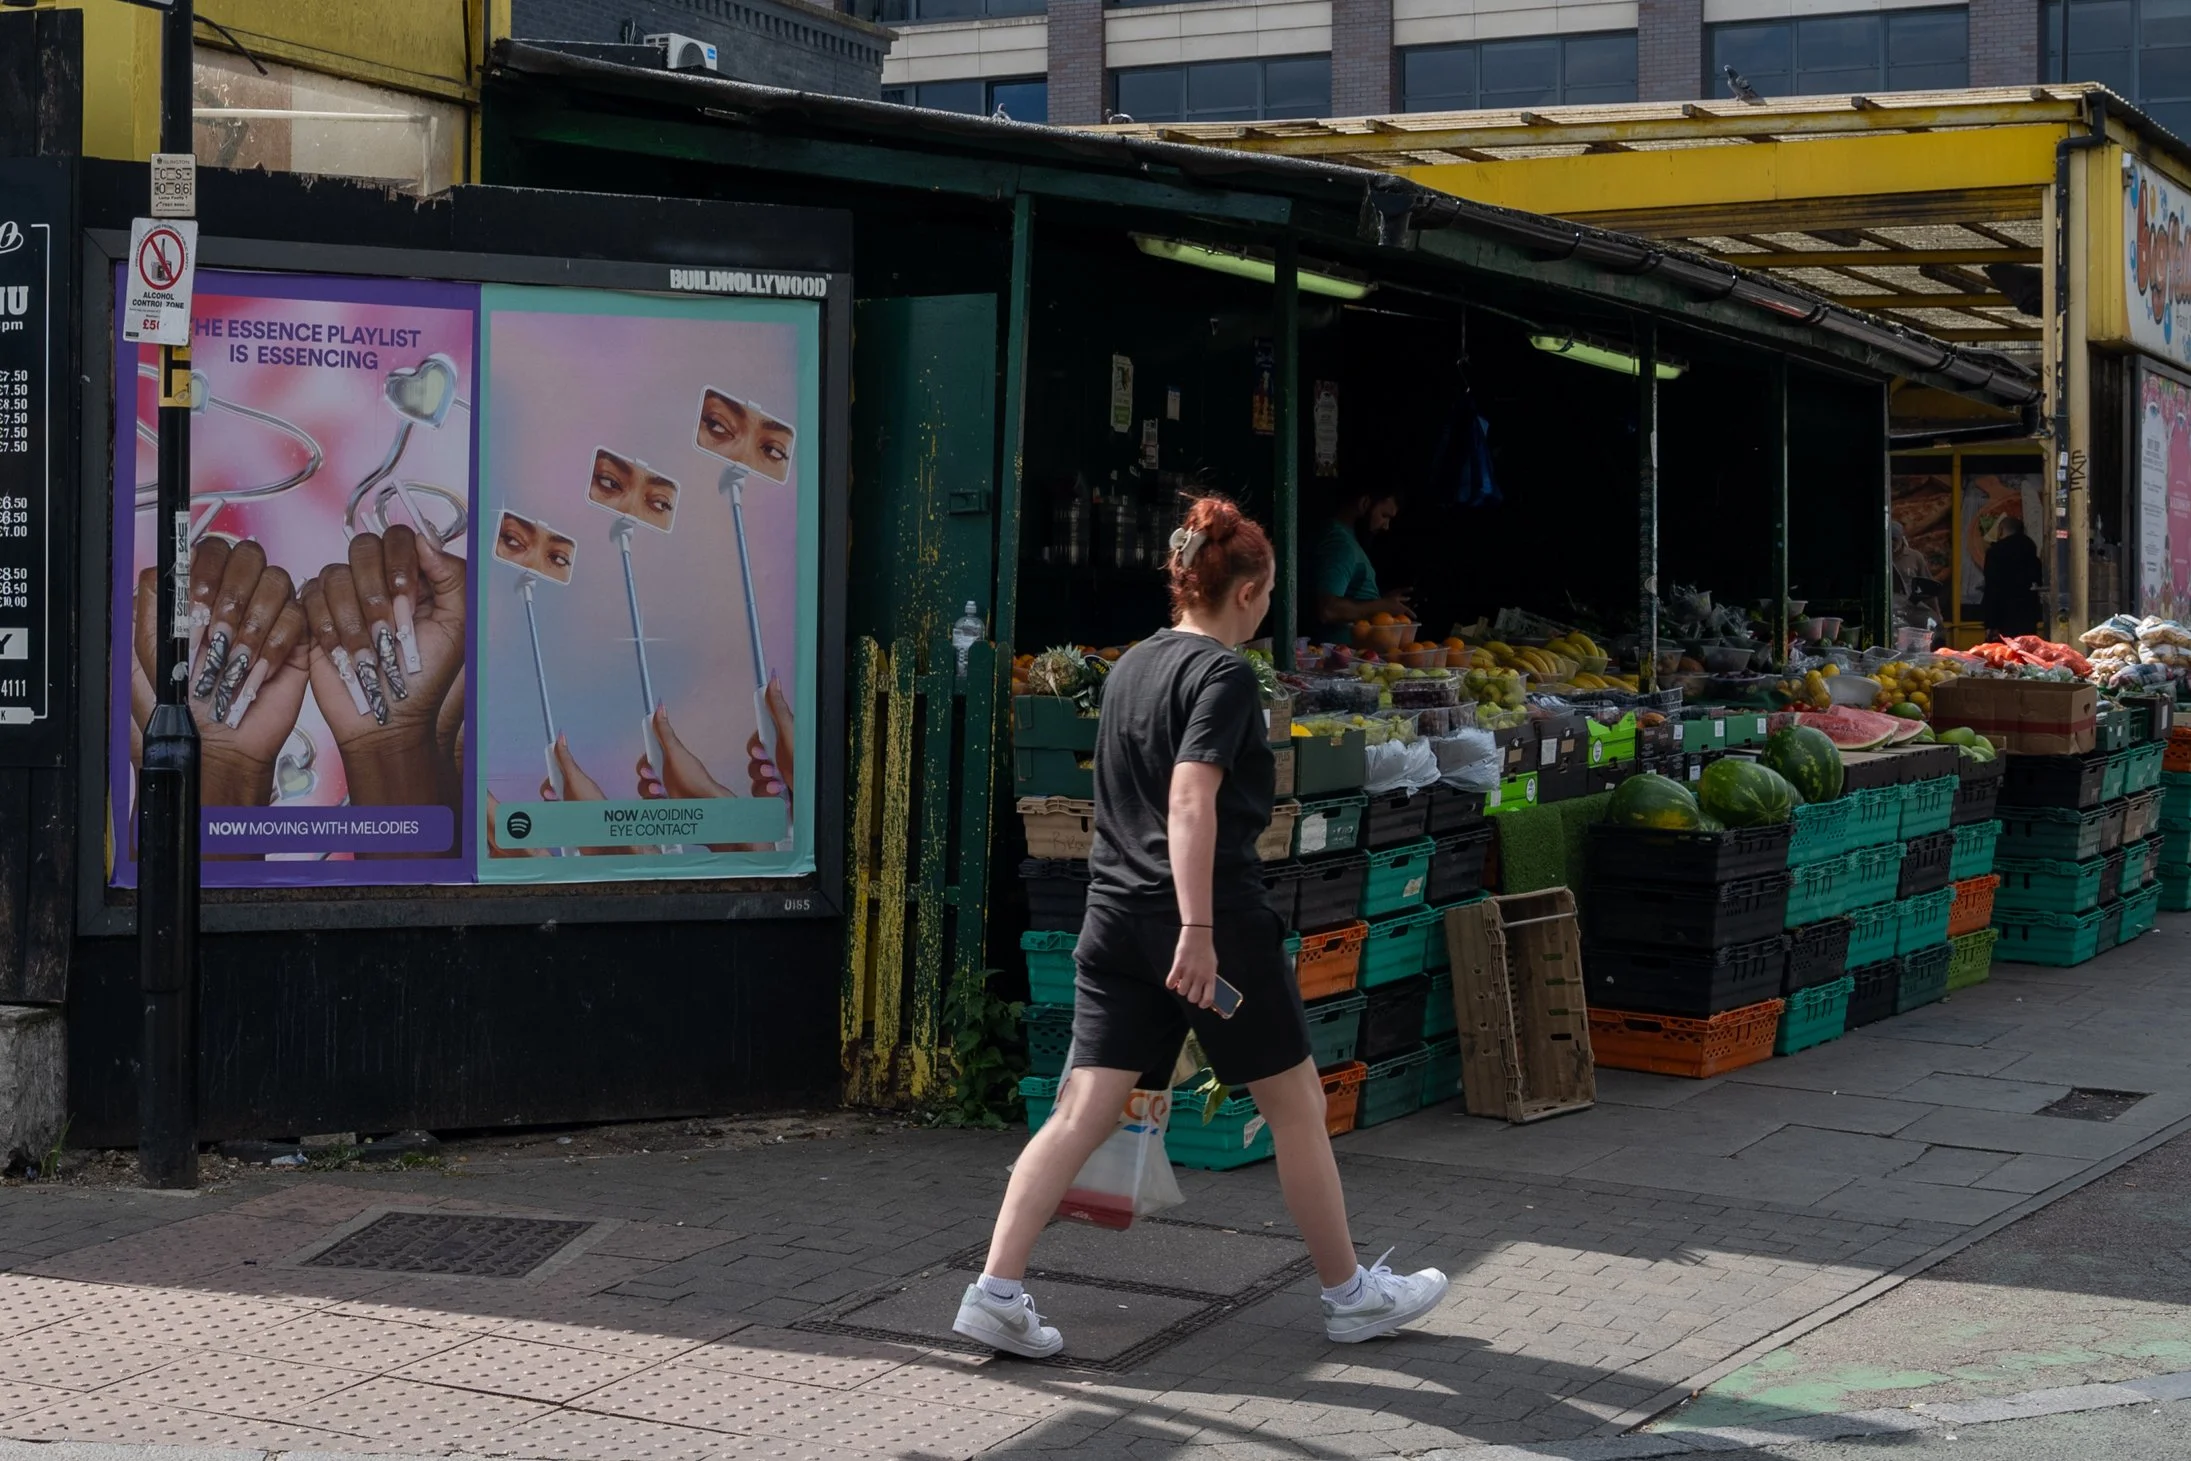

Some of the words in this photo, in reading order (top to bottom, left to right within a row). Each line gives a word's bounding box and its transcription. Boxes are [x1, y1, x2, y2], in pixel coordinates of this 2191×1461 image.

[670, 269, 827, 297] BUILDHOLLYWOOD
[142, 291, 175, 300] ALCOHOL
[228, 319, 322, 343] ESSENCE
[327, 325, 421, 348] PLAYLIST
[229, 344, 249, 363] IS
[257, 346, 378, 370] ESSENCING
[1, 679, 26, 697] 4111
[604, 810, 639, 823] NOW
[640, 808, 704, 821] AVOIDING
[208, 822, 246, 836] NOW
[249, 821, 308, 836] MOVING
[311, 821, 347, 835] WITH
[350, 820, 419, 835] MELODIES
[609, 823, 633, 837] EYE
[635, 823, 698, 836] CONTACT
